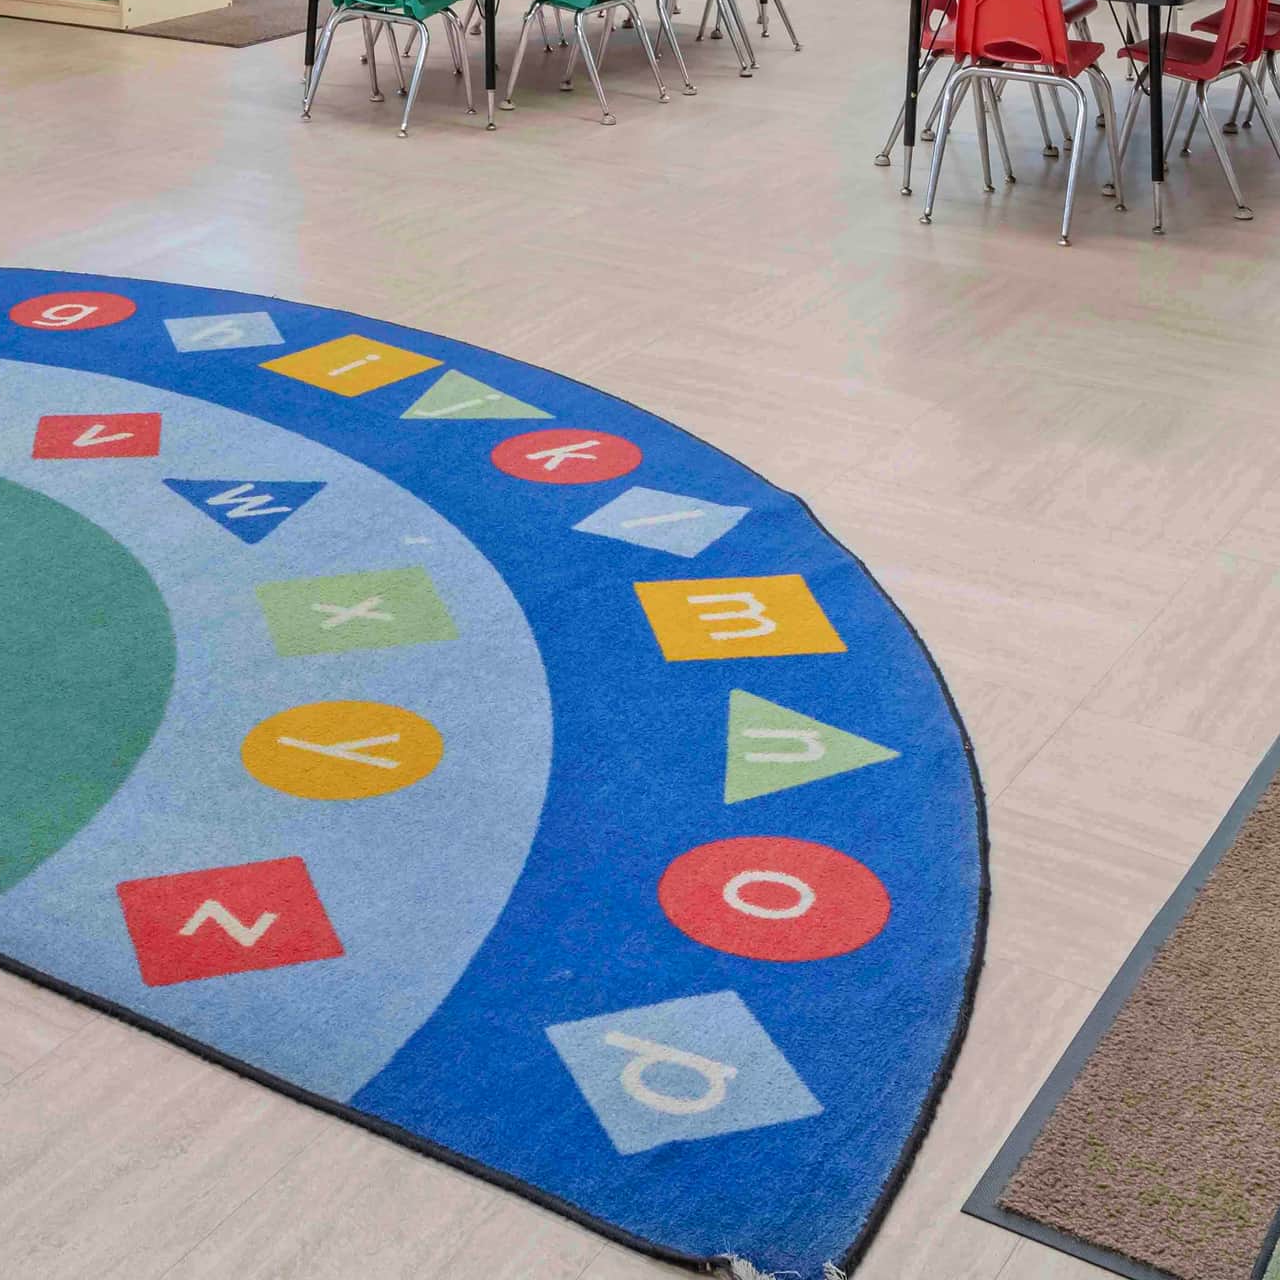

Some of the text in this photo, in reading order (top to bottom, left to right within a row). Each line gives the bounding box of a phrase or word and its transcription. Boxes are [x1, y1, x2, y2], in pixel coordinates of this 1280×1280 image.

[32, 303, 98, 327] g
[327, 353, 381, 377] i
[414, 393, 502, 417] j
[72, 424, 135, 447] v
[206, 483, 291, 518] w
[312, 595, 395, 629] x
[687, 592, 777, 640] m
[277, 731, 401, 770] y
[743, 727, 827, 763] n
[723, 869, 816, 921] o
[179, 899, 281, 948] z
[603, 1030, 737, 1115] p
